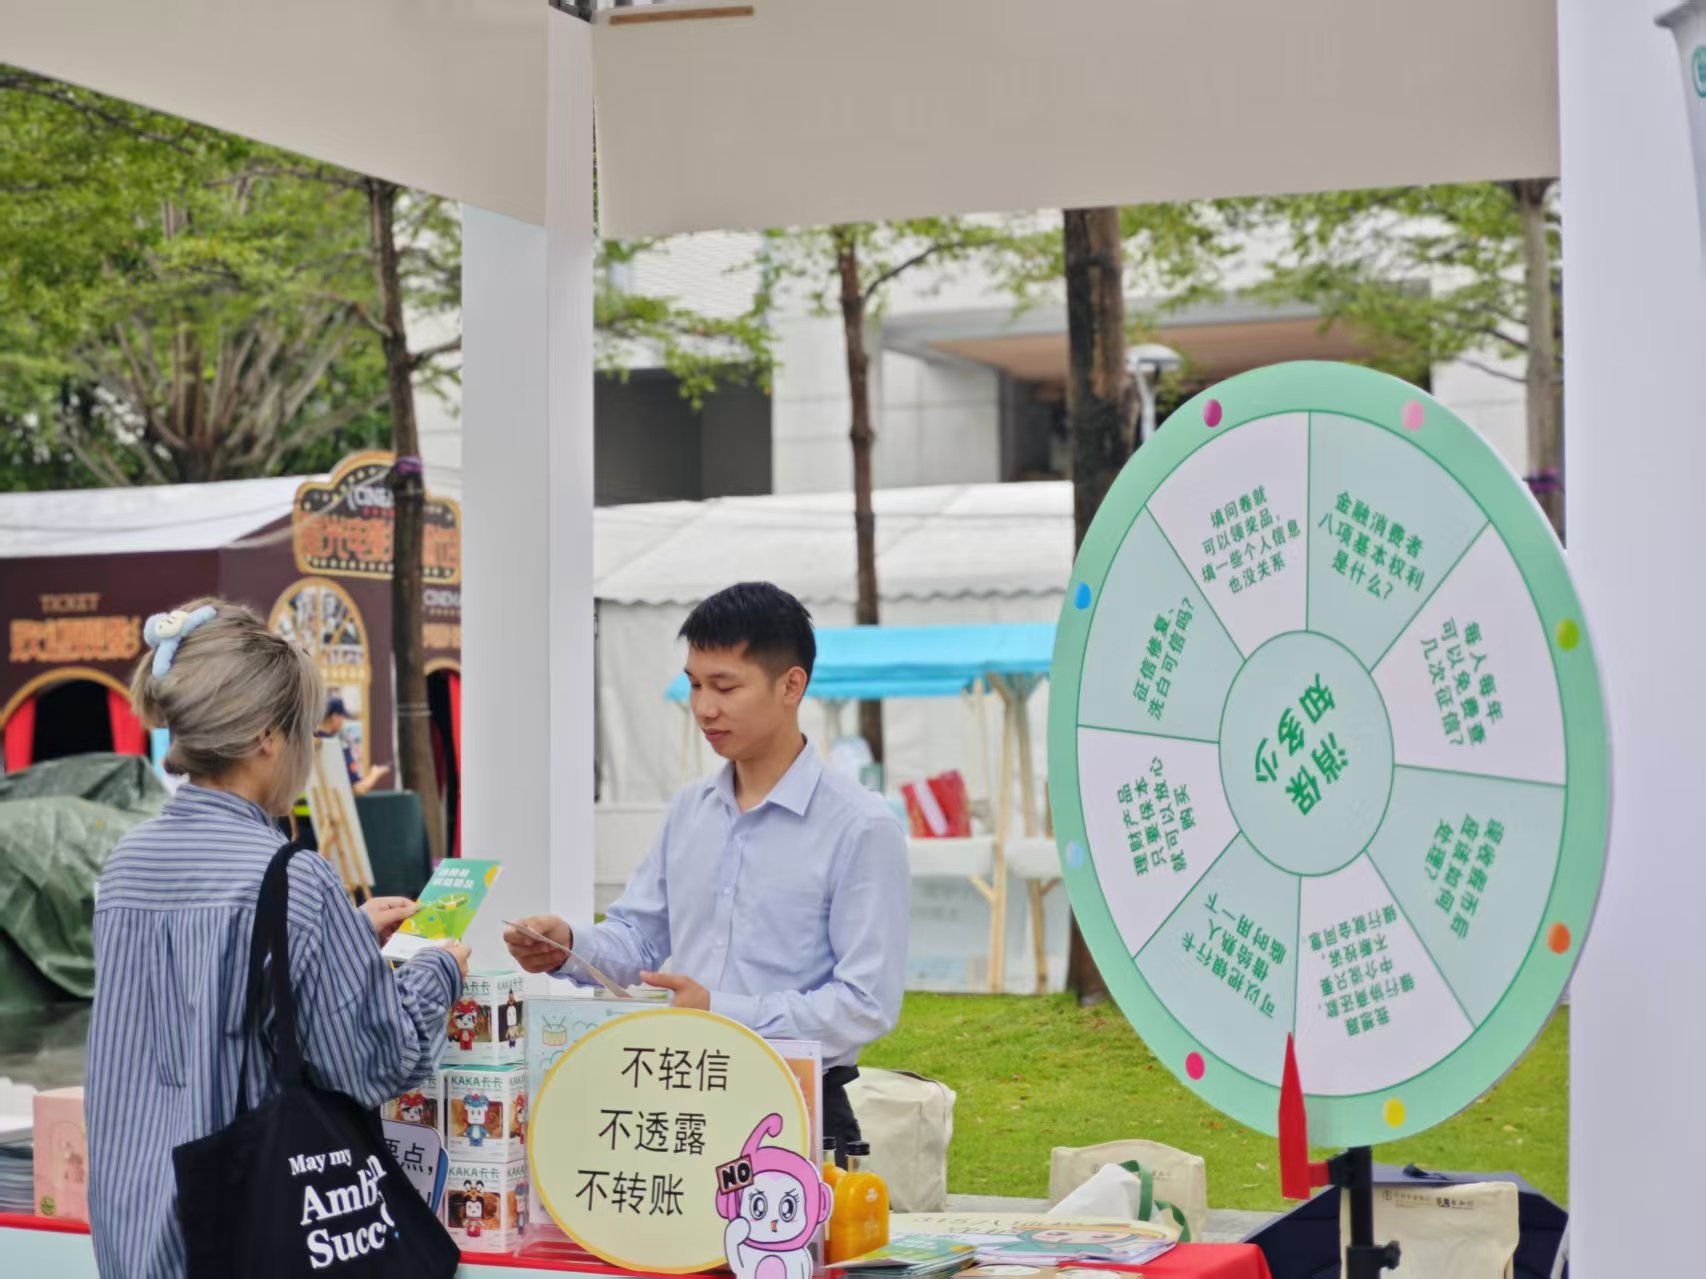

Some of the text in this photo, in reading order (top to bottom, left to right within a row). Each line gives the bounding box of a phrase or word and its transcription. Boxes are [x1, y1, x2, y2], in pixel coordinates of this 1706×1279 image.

[1210, 485, 1267, 528] 填问卷就
[1334, 491, 1424, 559] 金融消费者
[1202, 519, 1301, 583] 填一些个人信息
[1228, 551, 1285, 594] 也没关系
[1318, 513, 1425, 592] 八项基本权利
[1441, 616, 1486, 747] 可以免费查
[1465, 621, 1503, 725] 每人每年
[1255, 673, 1336, 783] 知多少
[1285, 732, 1349, 816] 消保
[1117, 783, 1149, 876] 理财产品
[1134, 776, 1167, 868] 只要保本
[1172, 783, 1196, 830] 购买
[1433, 813, 1479, 916] 应该如何
[1204, 892, 1286, 965] 临时用一下
[1208, 918, 1269, 982] 借给熟人
[1182, 931, 1275, 1019] 可以把银行卡
[1320, 956, 1393, 997] 中介说只要
[1345, 1006, 1390, 1036] 我想跟
[621, 1046, 731, 1092] 不轻信
[288, 1148, 352, 1176] May my
[598, 1109, 707, 1156] 不透露
[575, 1169, 685, 1216] 不转账
[721, 1162, 751, 1190] NO
